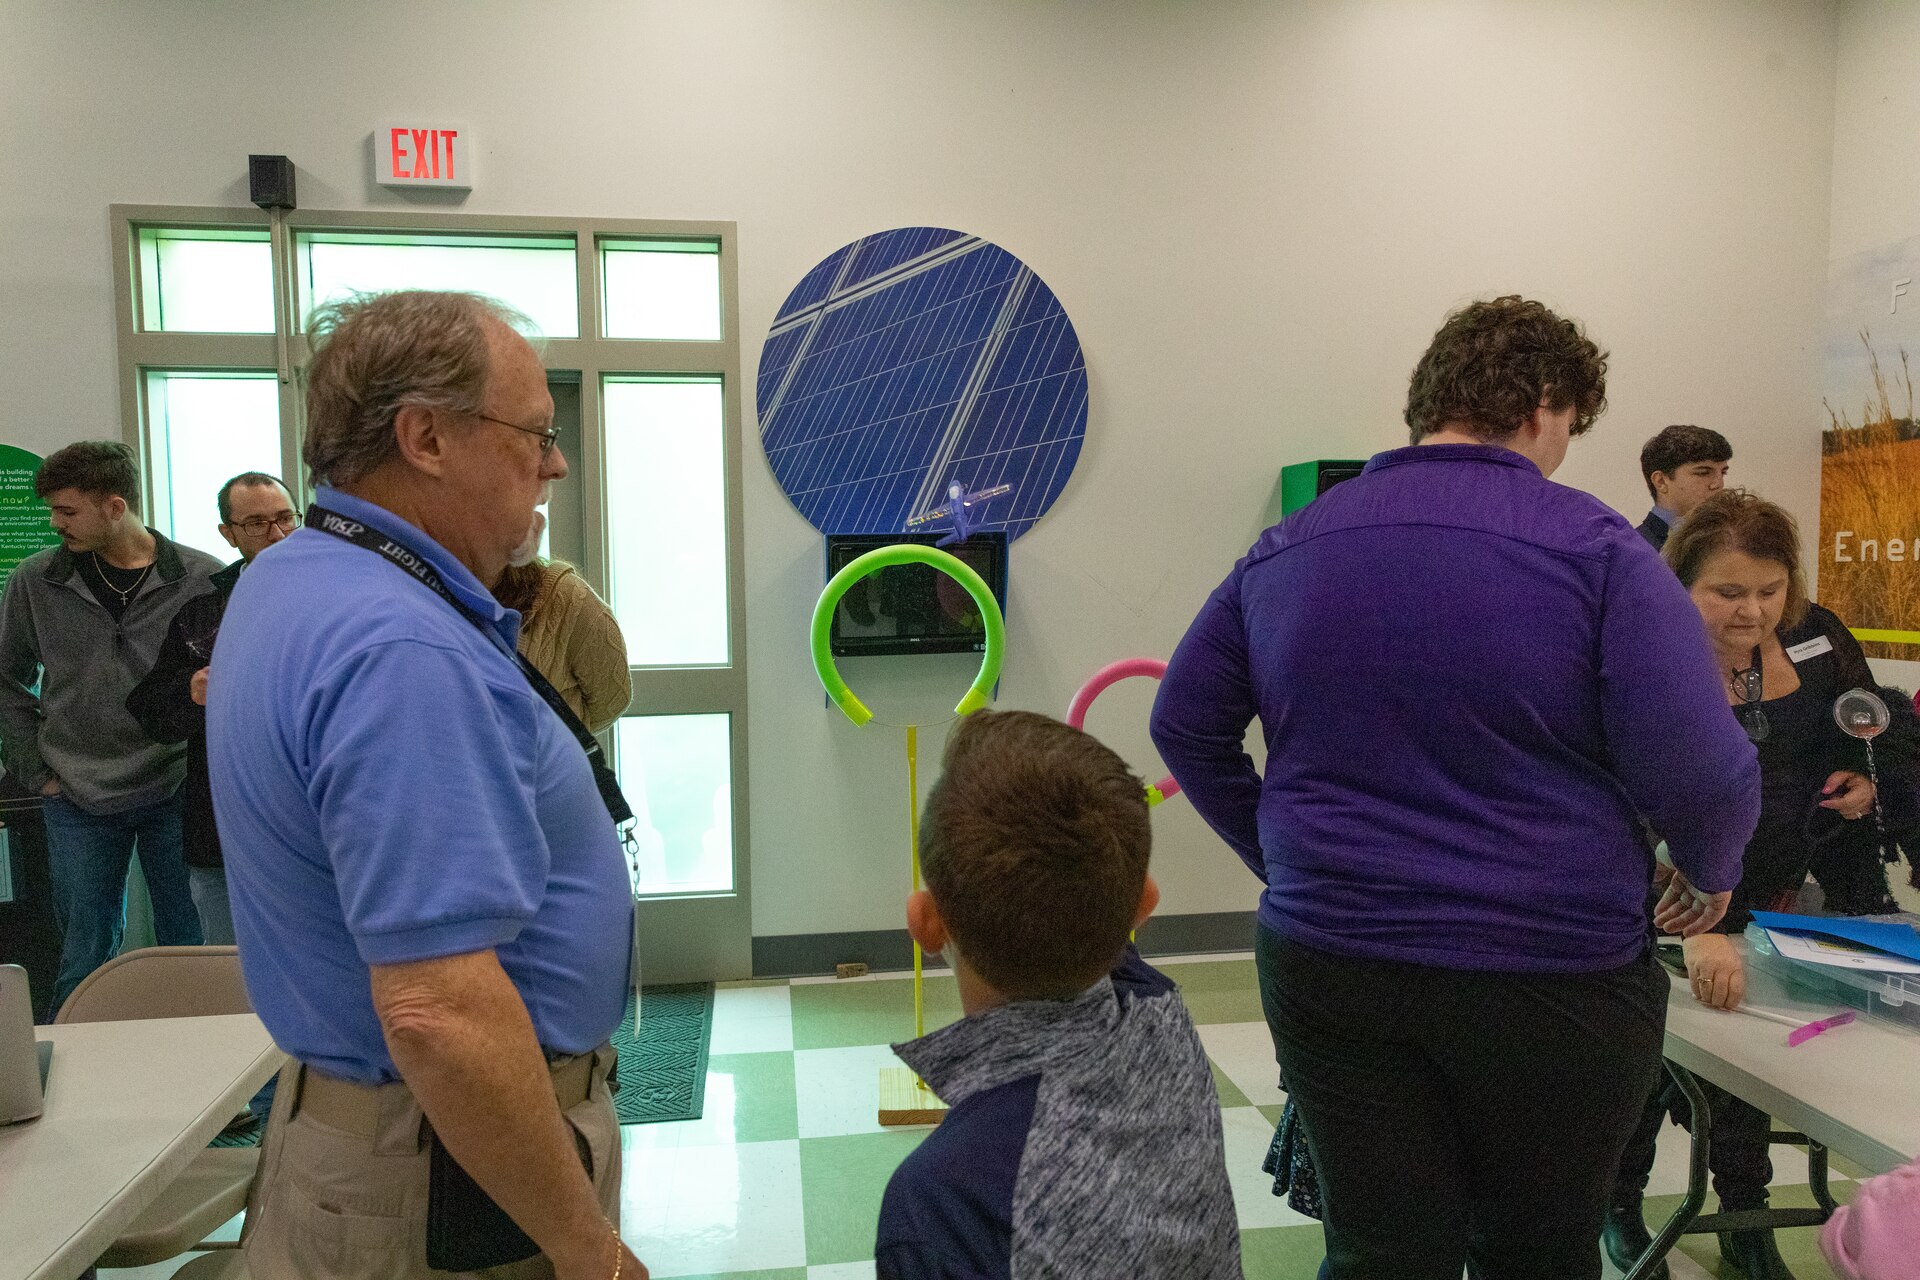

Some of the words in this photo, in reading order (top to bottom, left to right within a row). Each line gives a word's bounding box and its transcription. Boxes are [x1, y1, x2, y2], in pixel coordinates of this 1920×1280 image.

[391, 128, 458, 180] EXIT
[6, 468, 33, 476] building
[0, 496, 30, 504] now?
[379, 541, 428, 578] FIGHT
